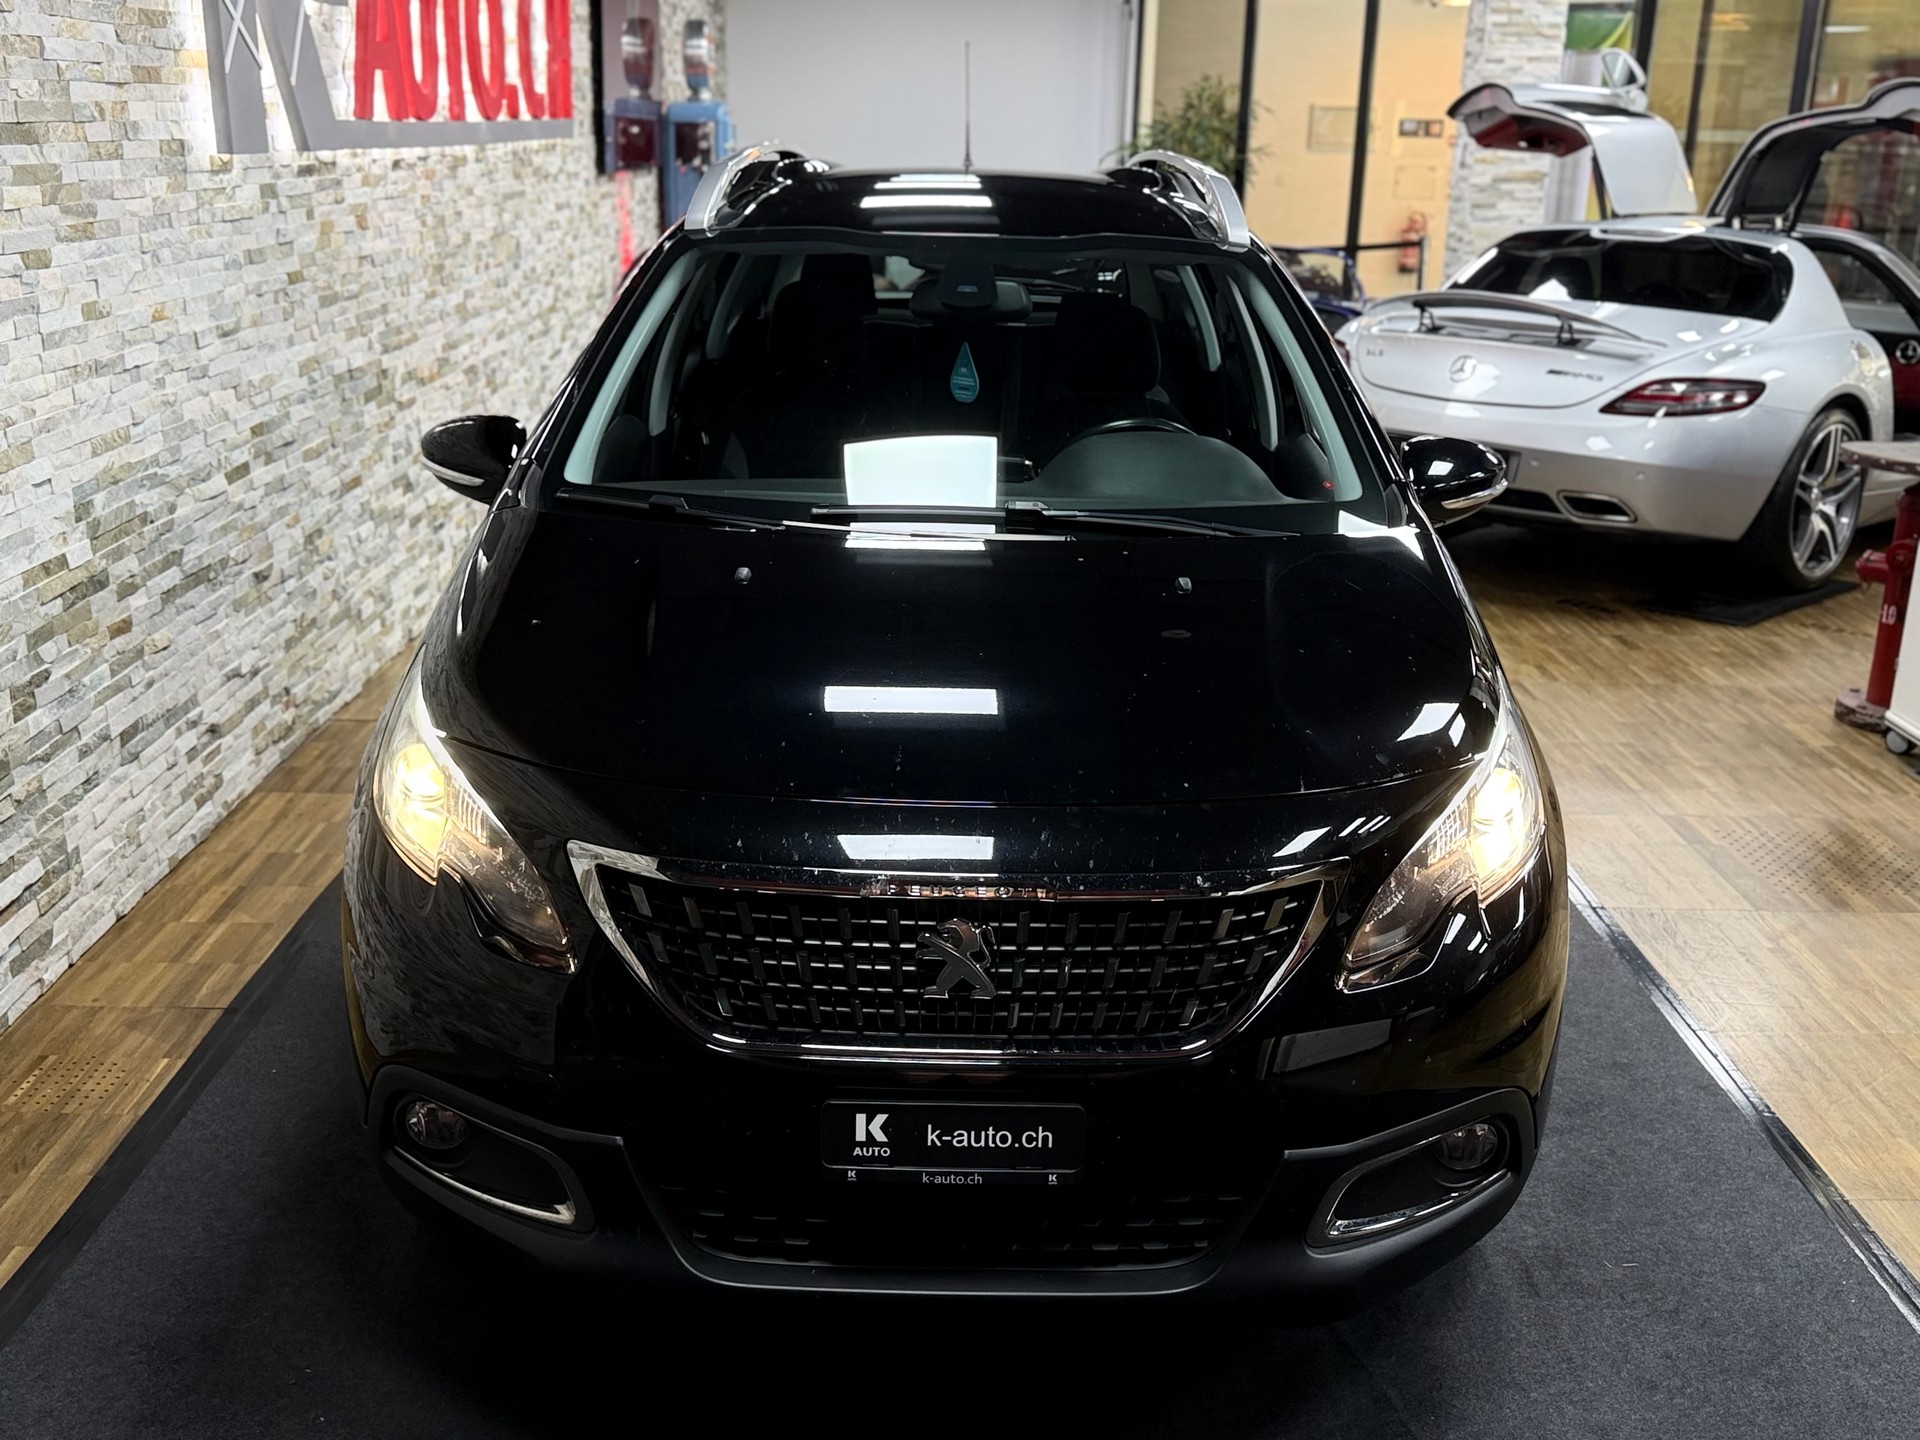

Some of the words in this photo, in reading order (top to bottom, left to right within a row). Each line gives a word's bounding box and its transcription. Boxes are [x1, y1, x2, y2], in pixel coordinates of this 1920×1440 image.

[855, 1113, 889, 1142] K
[927, 1124, 1053, 1148] k-auto.ch
[853, 1146, 890, 1157] AUTO
[922, 1172, 983, 1184] k-auto.ch
